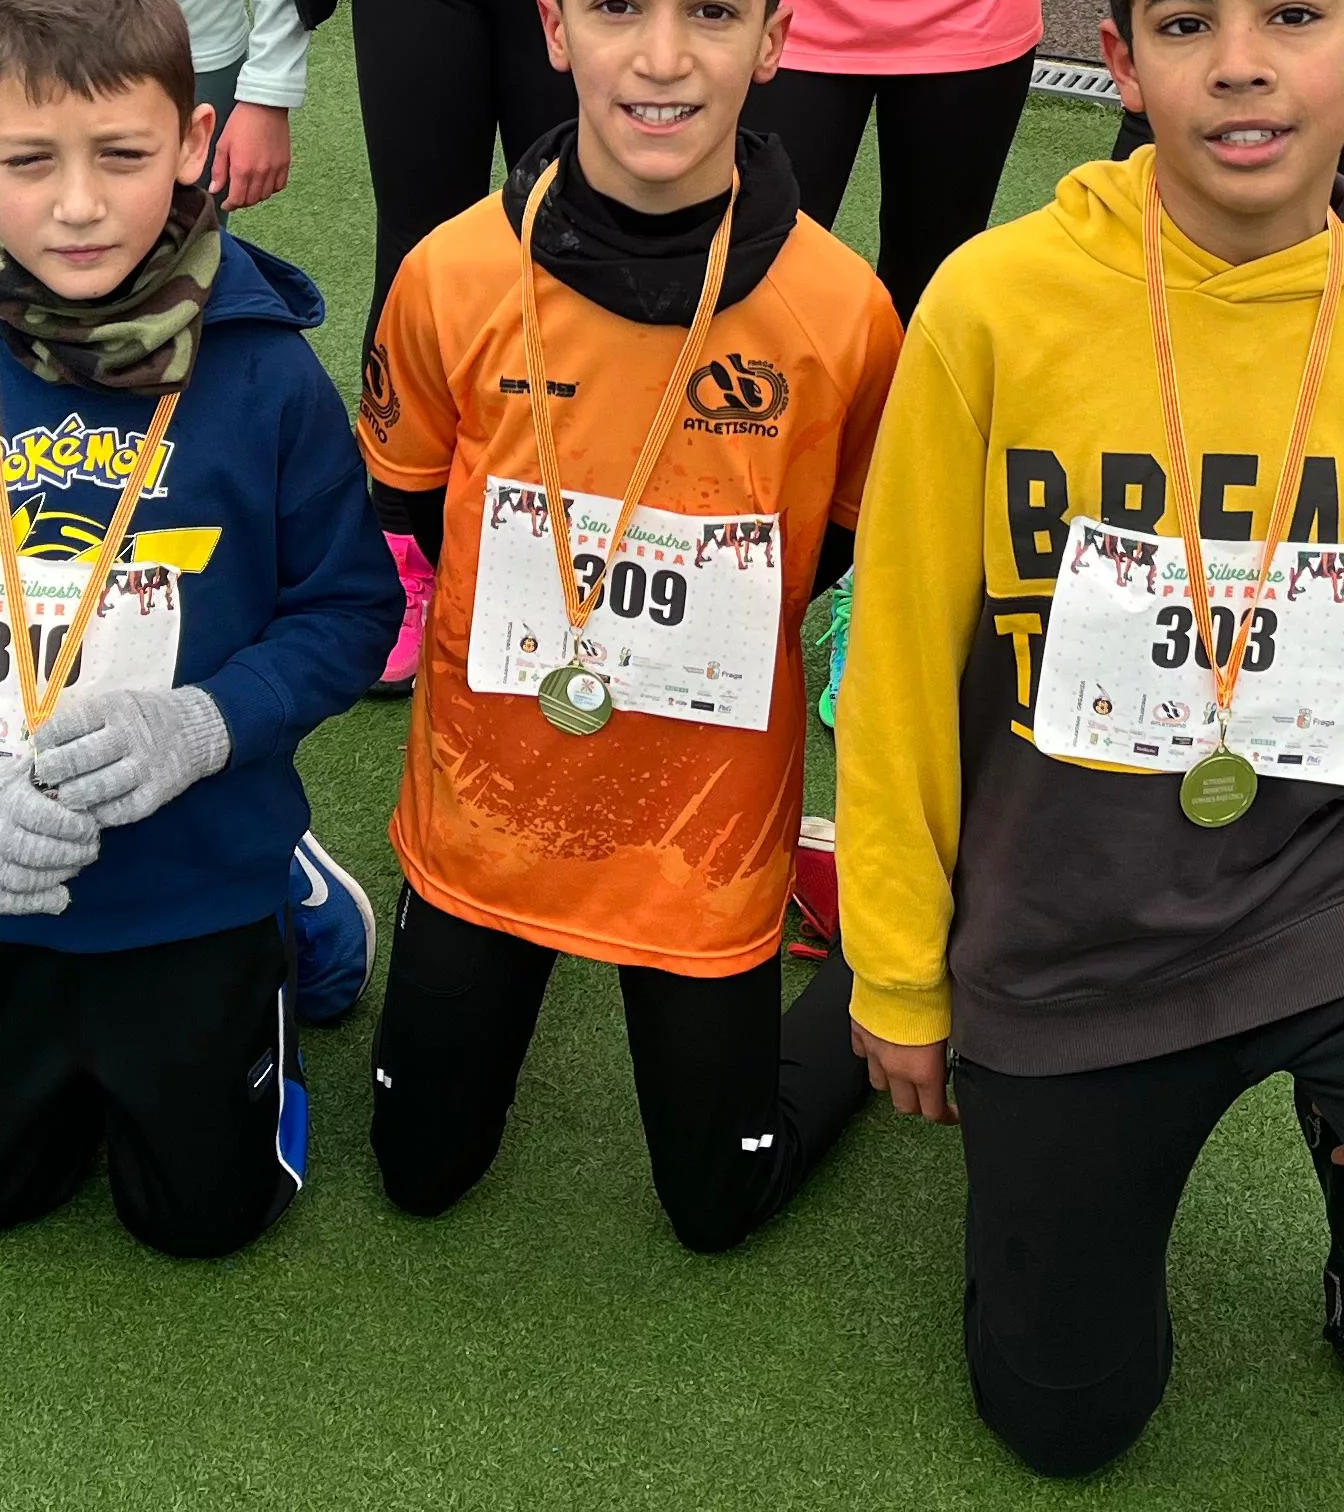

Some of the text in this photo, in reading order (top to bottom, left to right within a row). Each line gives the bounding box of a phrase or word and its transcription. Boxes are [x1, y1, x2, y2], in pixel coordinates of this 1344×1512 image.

[683, 417, 779, 438] ATLETISMO
[576, 515, 692, 551] San ilvestre
[1161, 562, 1189, 580] Sa
[572, 553, 687, 626] 309
[1151, 605, 1278, 673] 303
